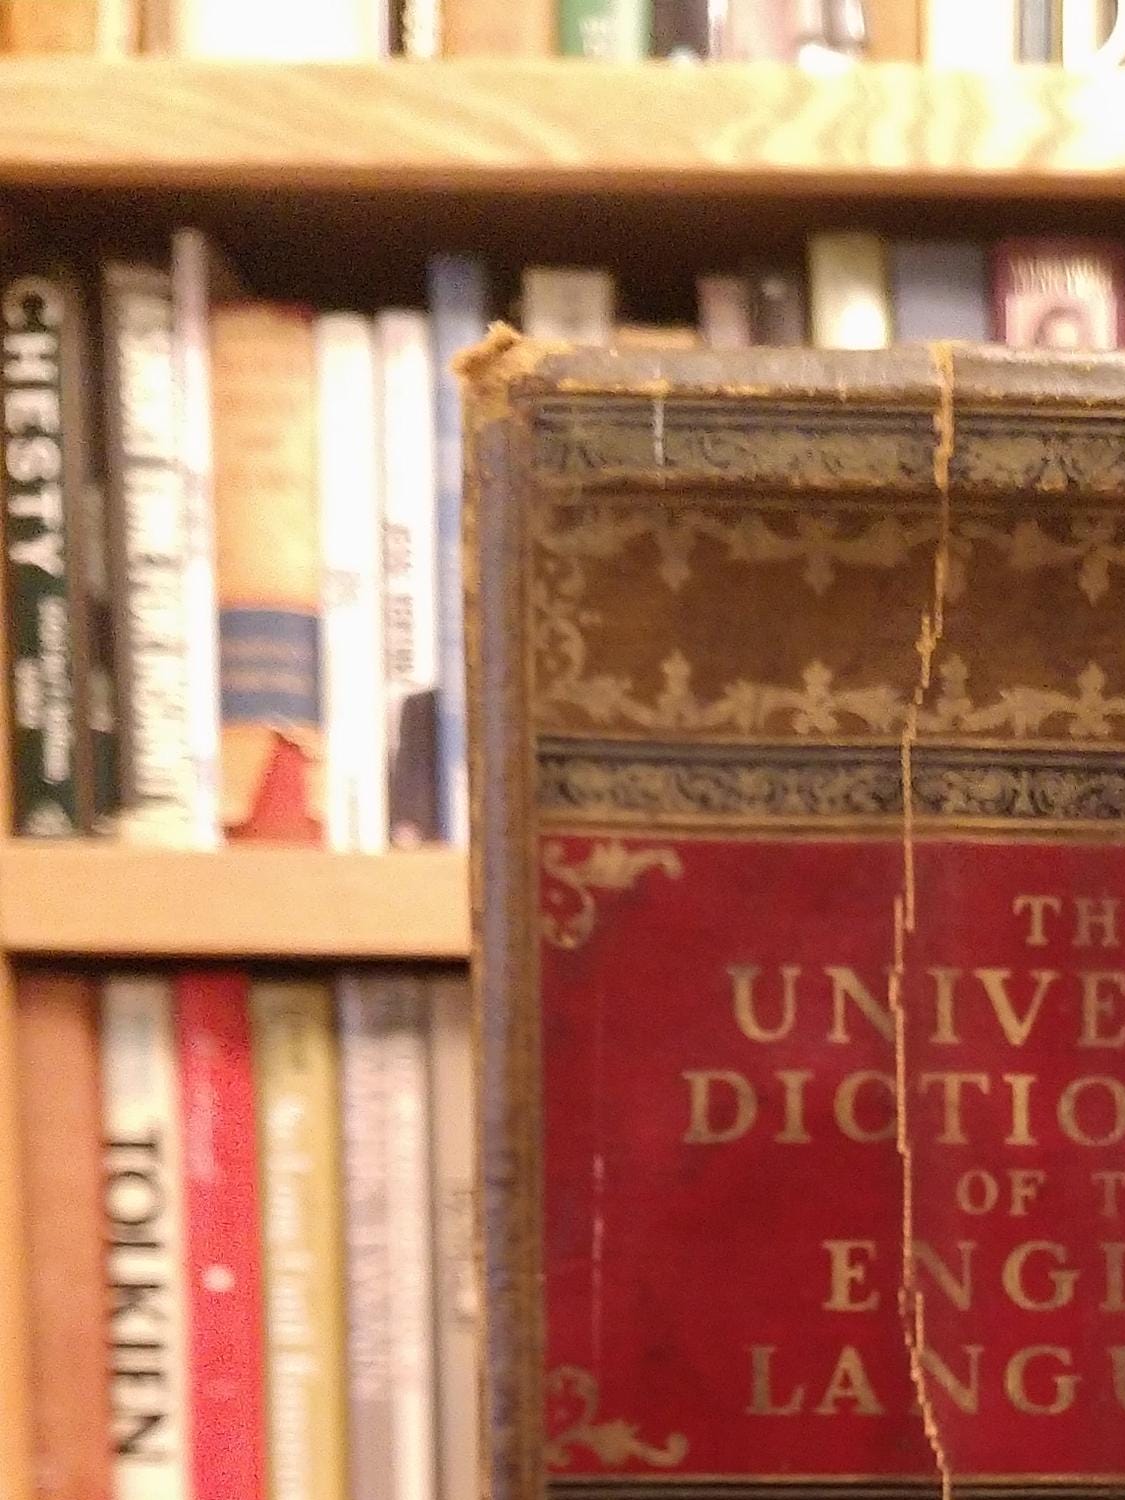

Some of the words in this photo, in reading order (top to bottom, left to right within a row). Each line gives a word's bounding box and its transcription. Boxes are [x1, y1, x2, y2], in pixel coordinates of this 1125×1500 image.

[3, 276, 66, 577] CHESTY
[102, 1128, 168, 1464] TOLKIEN
[956, 1169, 1047, 1216] OF
